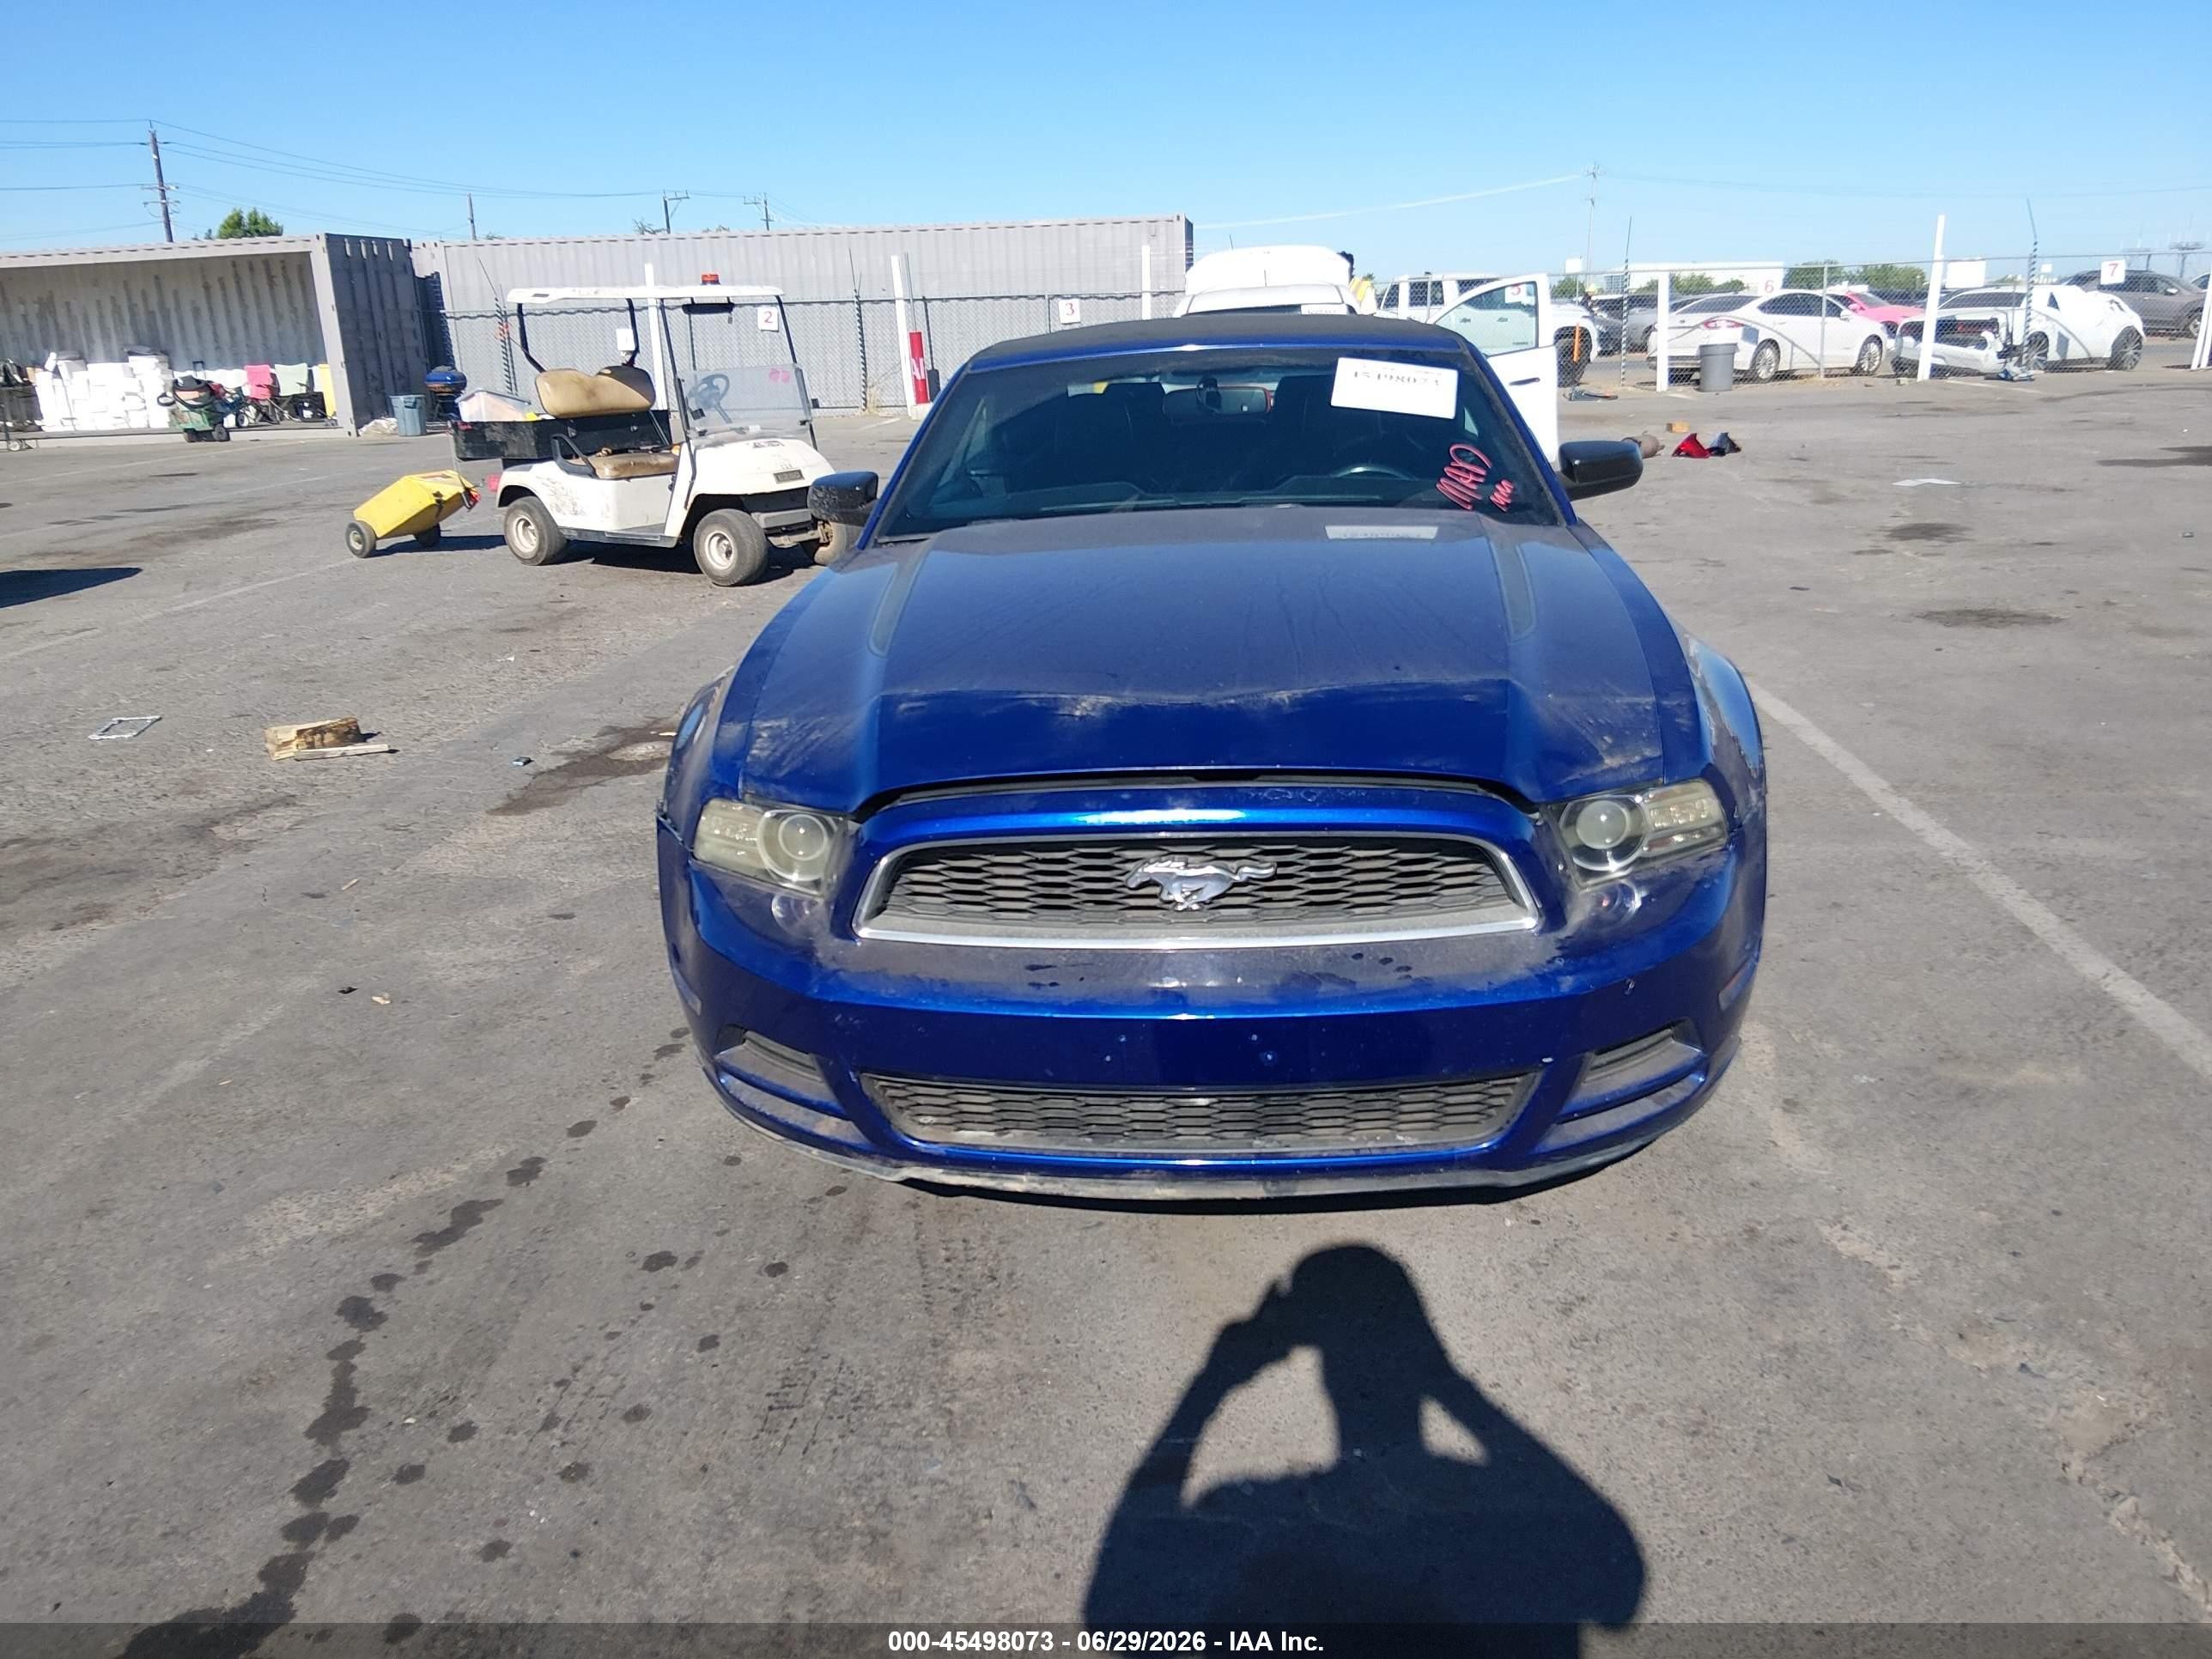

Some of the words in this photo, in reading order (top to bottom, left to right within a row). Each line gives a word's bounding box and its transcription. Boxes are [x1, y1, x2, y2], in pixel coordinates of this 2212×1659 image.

[2108, 263, 2119, 276] 7
[1765, 279, 1774, 293] 6
[1065, 302, 1075, 316] 3
[763, 310, 774, 324] 2
